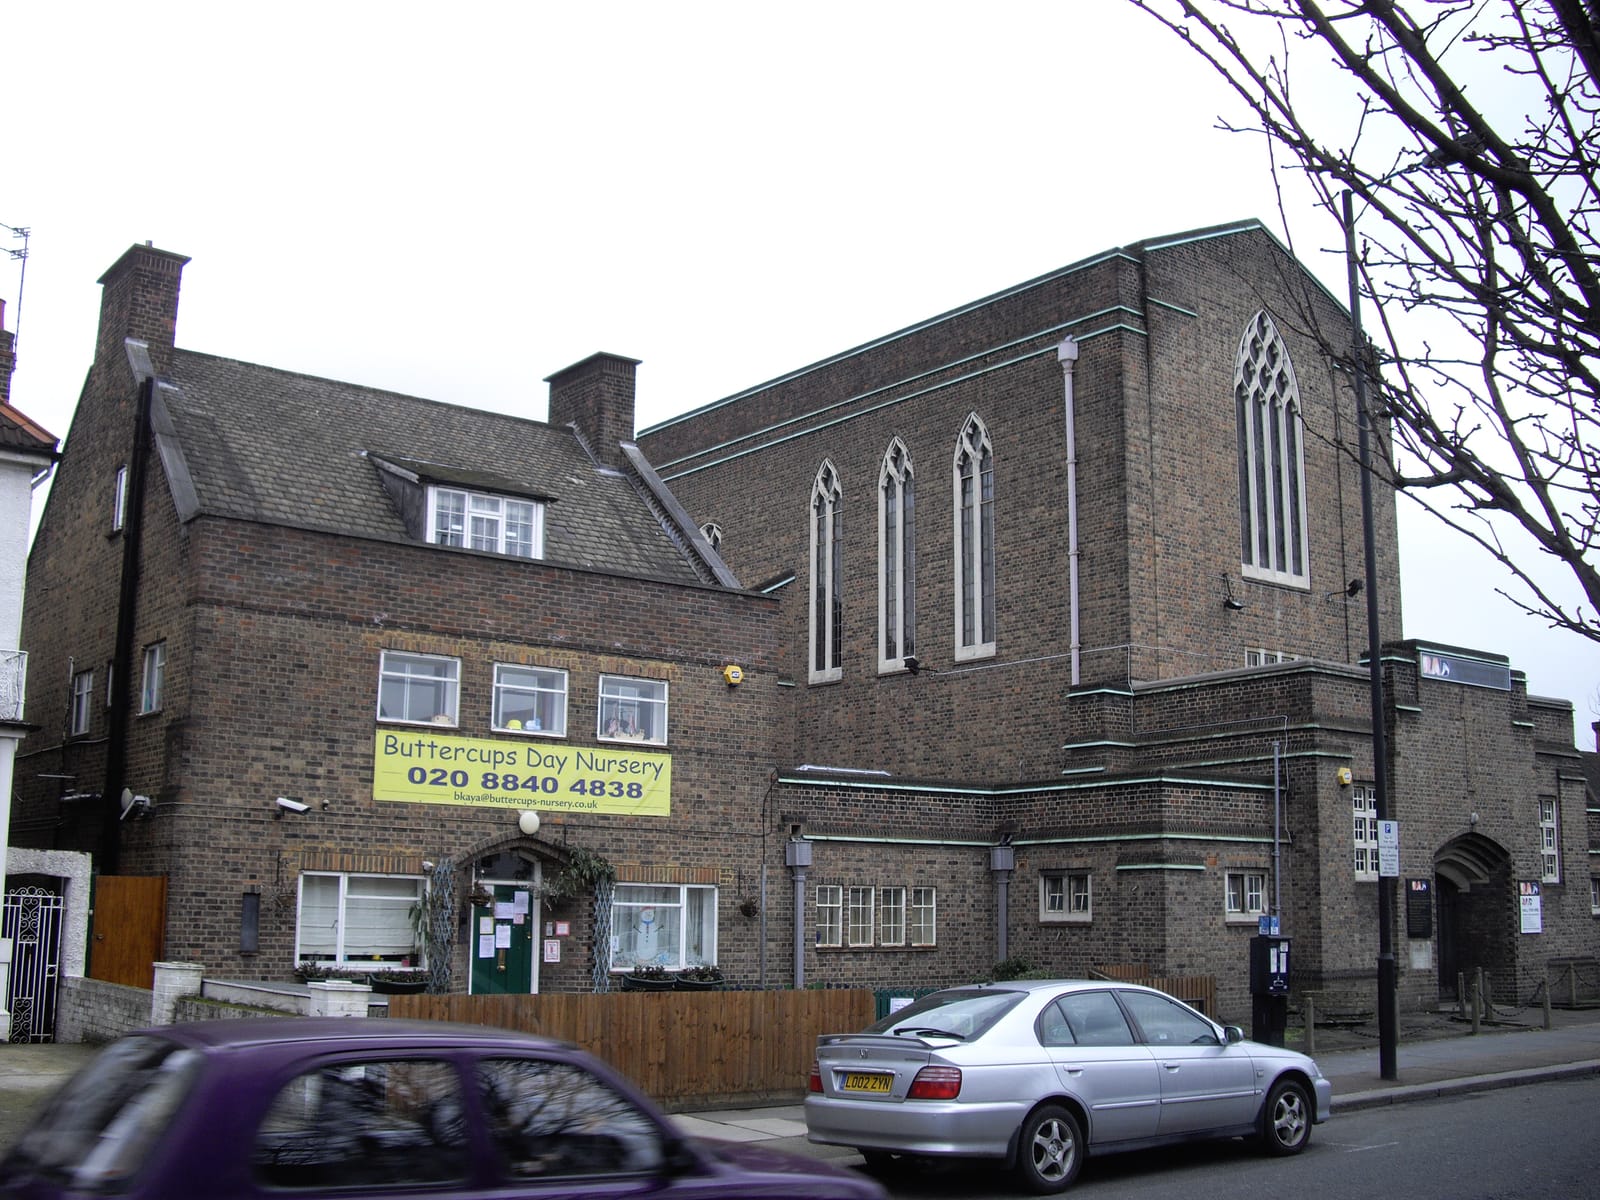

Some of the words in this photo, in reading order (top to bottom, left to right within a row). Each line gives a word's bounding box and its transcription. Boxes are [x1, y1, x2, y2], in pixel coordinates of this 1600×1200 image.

[384, 734, 517, 770] Buttercups
[527, 746, 568, 775] Day
[576, 750, 664, 781] Nursery
[407, 767, 469, 788] 020
[481, 772, 557, 793] 8840
[569, 779, 643, 799] 4838
[454, 791, 598, 810] bkaya@buttercups-nursery.co.uk
[870, 1077, 891, 1090] ZYN
